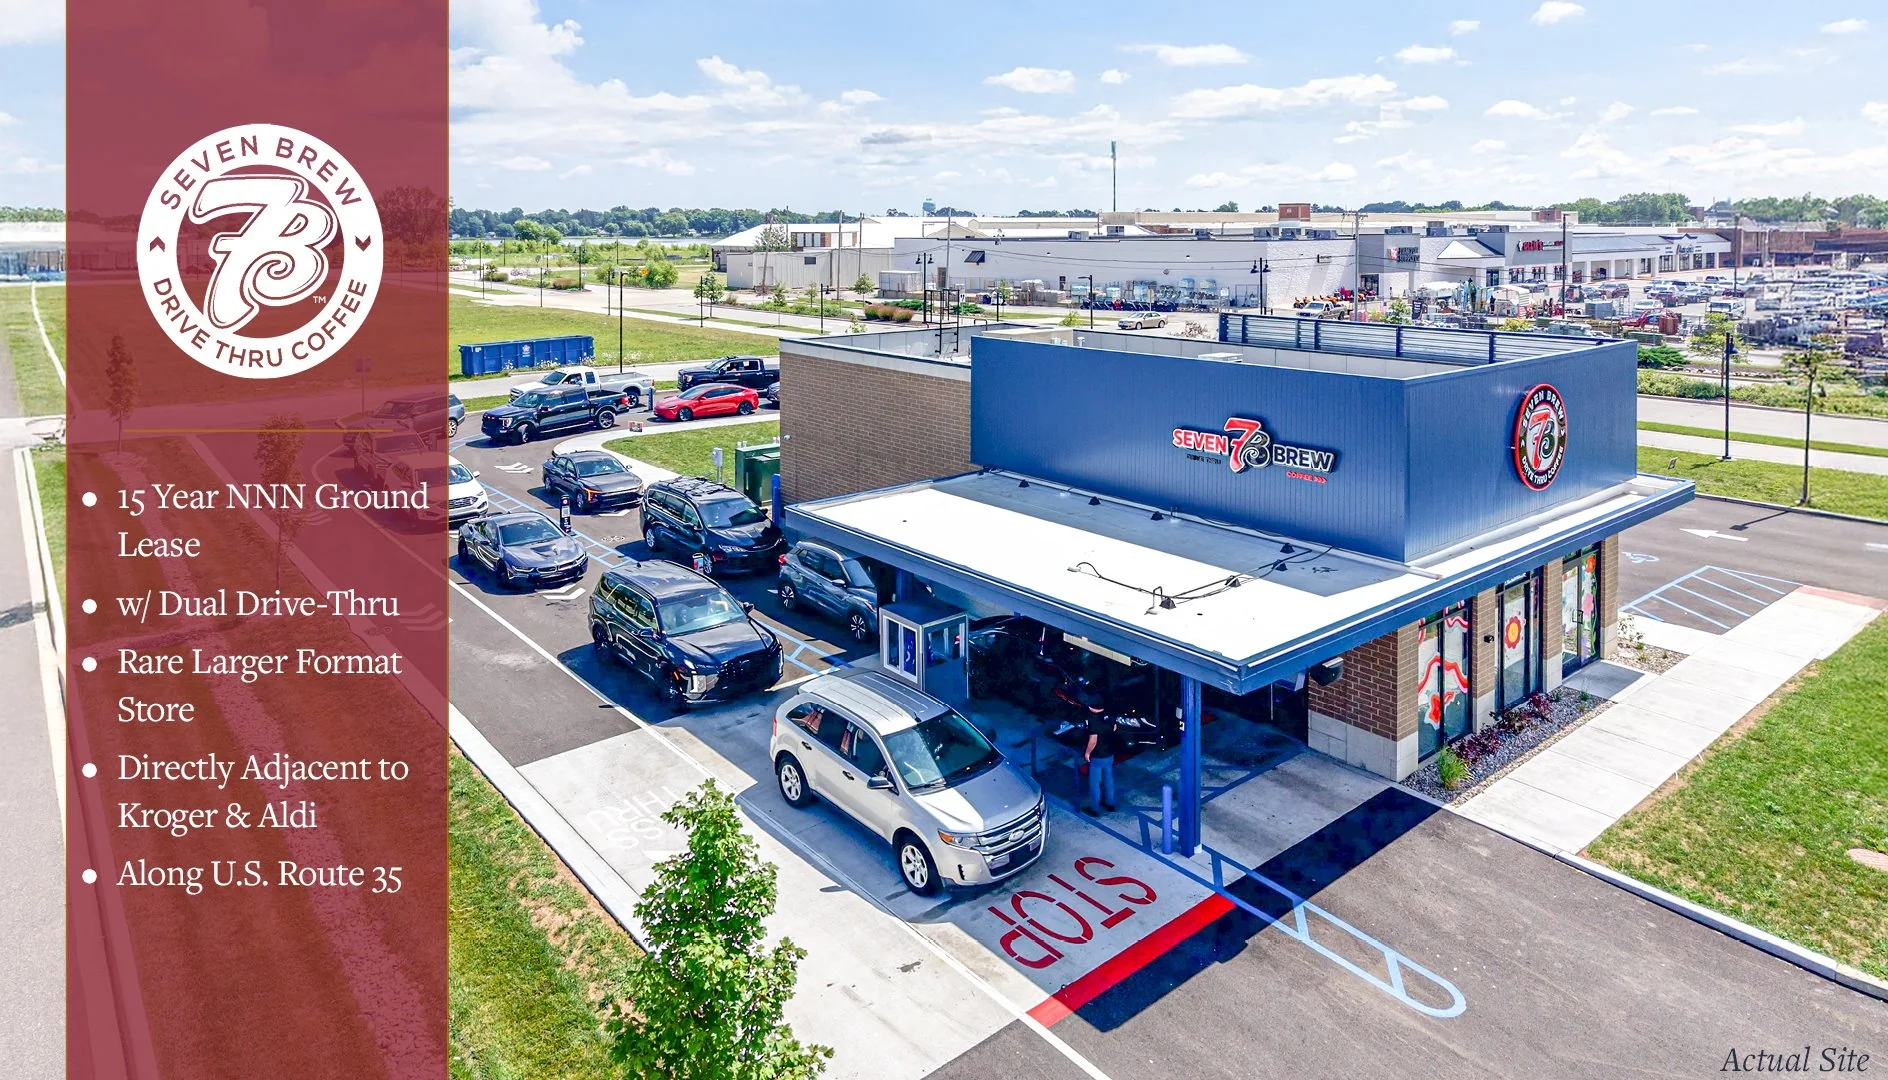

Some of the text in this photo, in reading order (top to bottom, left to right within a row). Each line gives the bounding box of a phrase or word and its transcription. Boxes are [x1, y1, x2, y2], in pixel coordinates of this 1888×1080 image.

[1522, 390, 1565, 429] SEVEN BREW
[1172, 428, 1229, 456] SEVEN
[1273, 443, 1335, 472] BREW
[987, 856, 1157, 969] STOP
